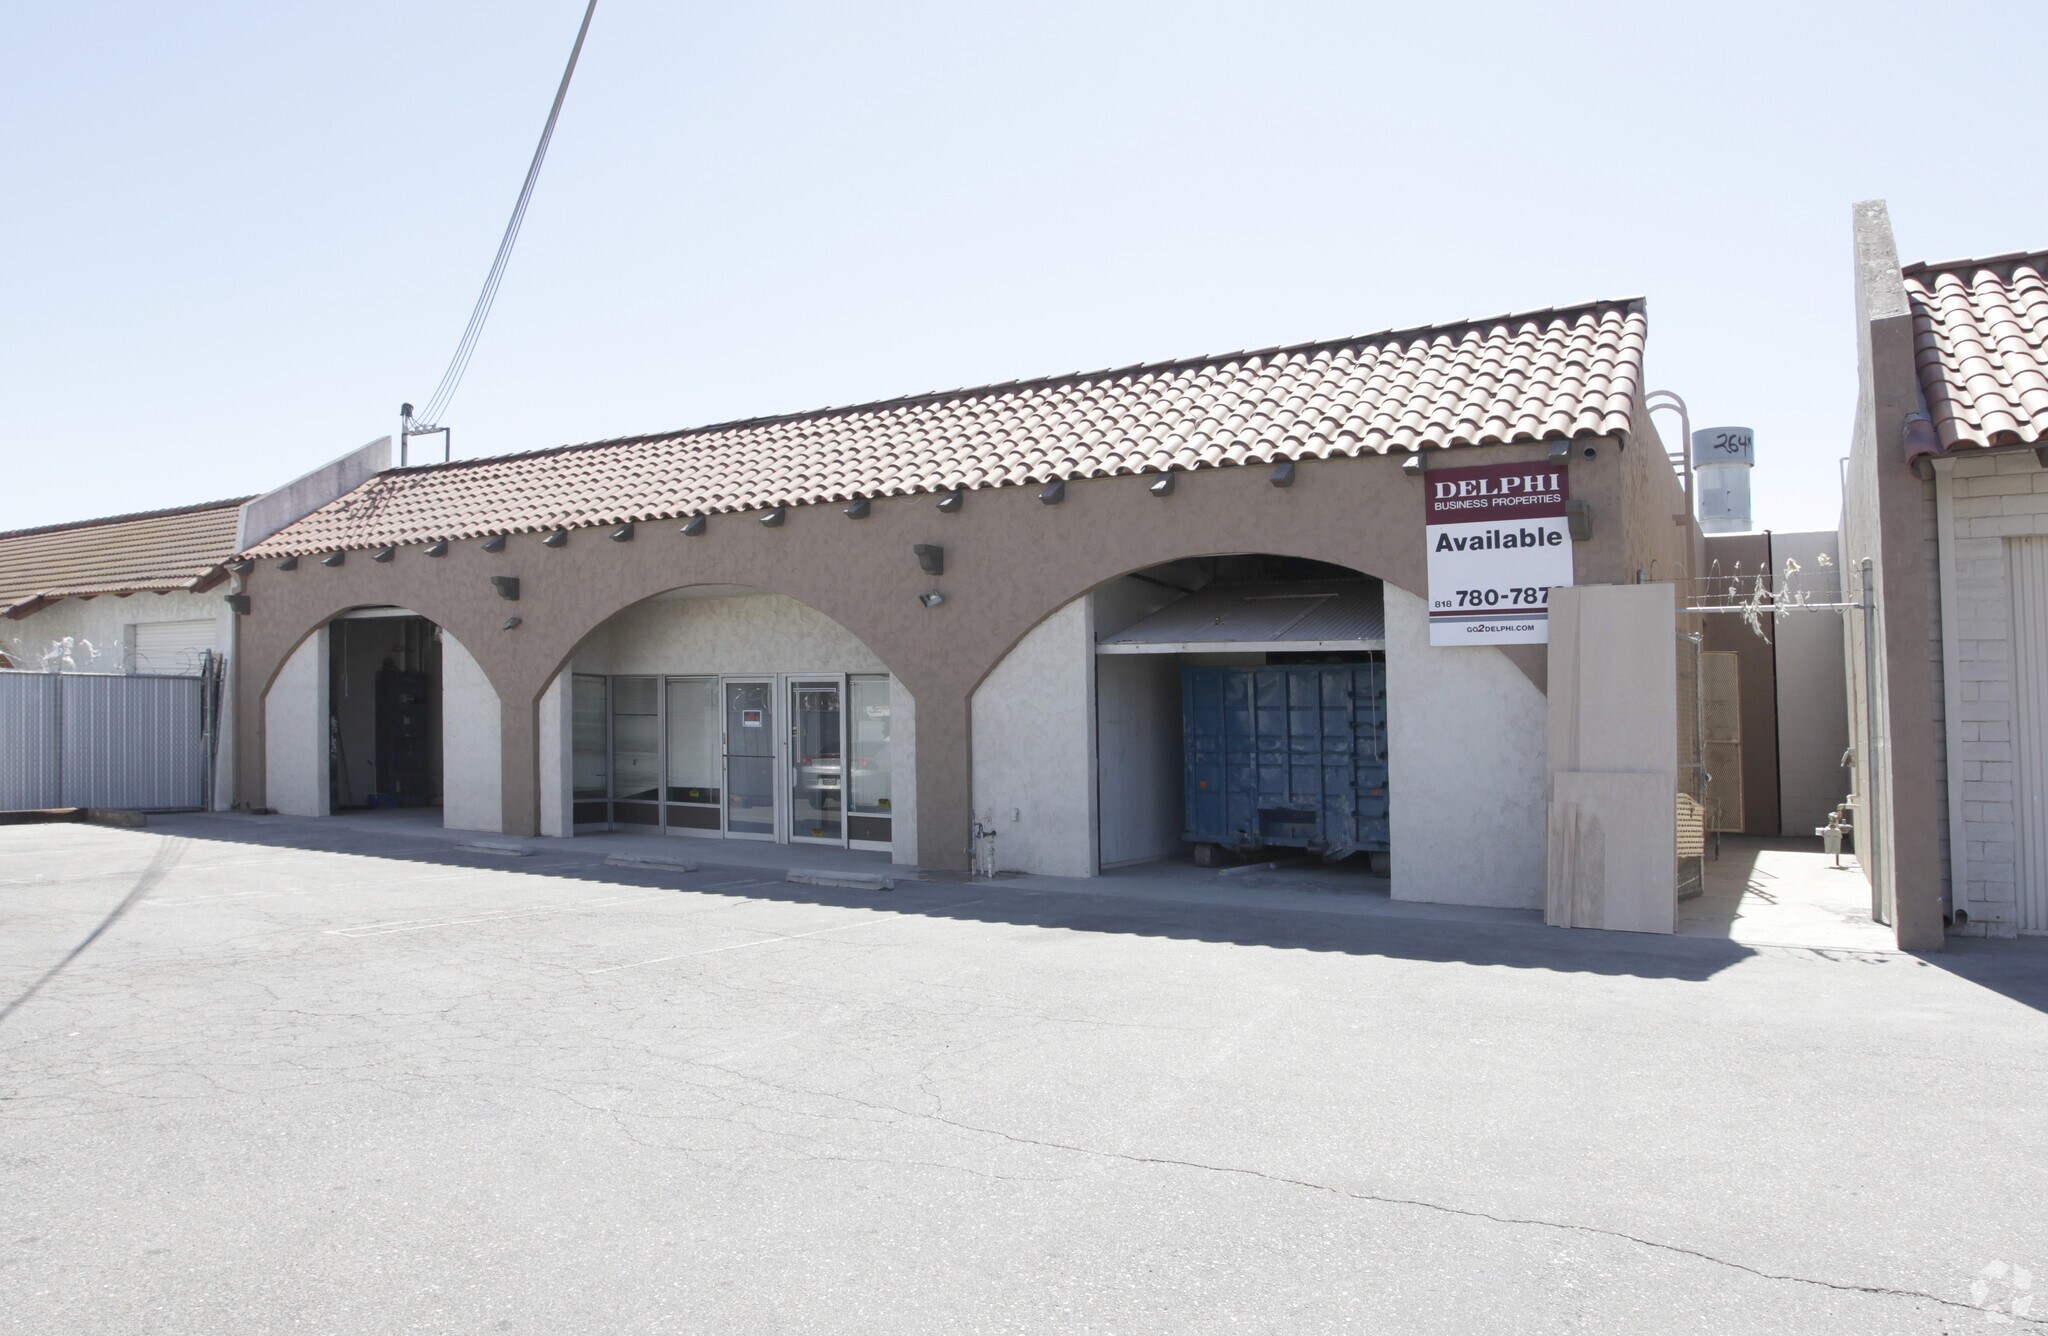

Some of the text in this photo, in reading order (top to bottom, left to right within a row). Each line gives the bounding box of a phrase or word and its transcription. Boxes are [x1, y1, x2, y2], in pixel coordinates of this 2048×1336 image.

[1434, 473, 1560, 499] DELPHI
[1434, 494, 1561, 511] BUSINESS PROPERTIES
[1435, 527, 1563, 552] Available
[1434, 586, 1564, 608] 818 780-787
[1466, 624, 1535, 633] GO2DELPHI.COM
